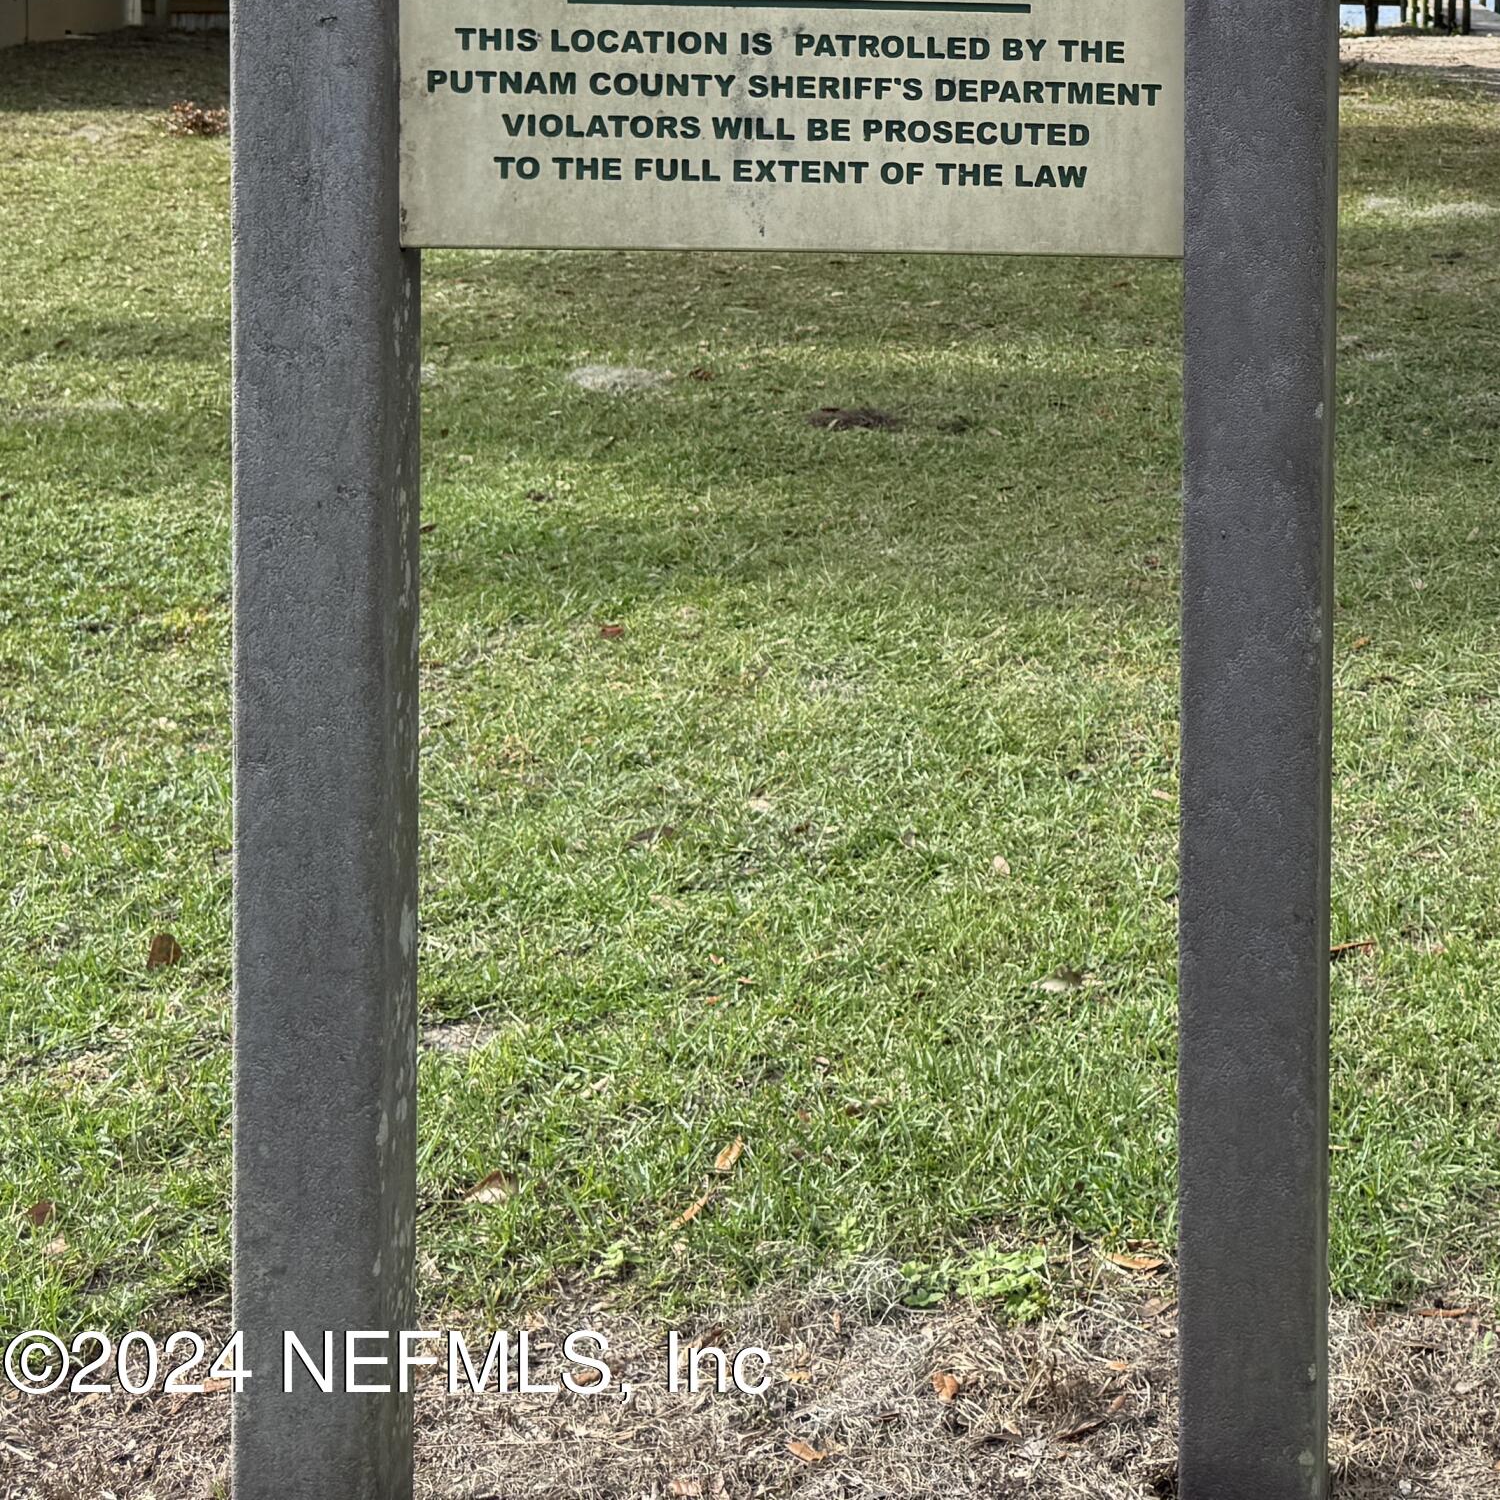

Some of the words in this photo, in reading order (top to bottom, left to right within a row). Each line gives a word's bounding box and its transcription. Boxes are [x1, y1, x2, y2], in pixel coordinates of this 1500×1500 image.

[454, 27, 538, 52] THIS
[550, 29, 727, 55] LOCATION
[740, 32, 773, 56] IS
[795, 32, 990, 60] PATROLLED
[1002, 38, 1047, 62] BY
[1057, 39, 1125, 64] THE
[427, 69, 577, 95] PUTNAM
[589, 72, 736, 97] COUNTY
[748, 74, 923, 101] SHERIFF'S
[935, 78, 1163, 107] DEPARTMENT
[501, 113, 701, 139] VIOLATORS
[711, 116, 795, 141] WILL
[807, 118, 851, 142] BE
[863, 119, 1090, 146] PROSECUTED
[493, 156, 540, 180] TO
[551, 157, 622, 181] THE
[634, 158, 721, 182] FULL
[733, 159, 869, 184] EXTENT
[880, 161, 924, 185] OF
[935, 162, 1003, 187] THE
[1015, 164, 1088, 188] LAW
